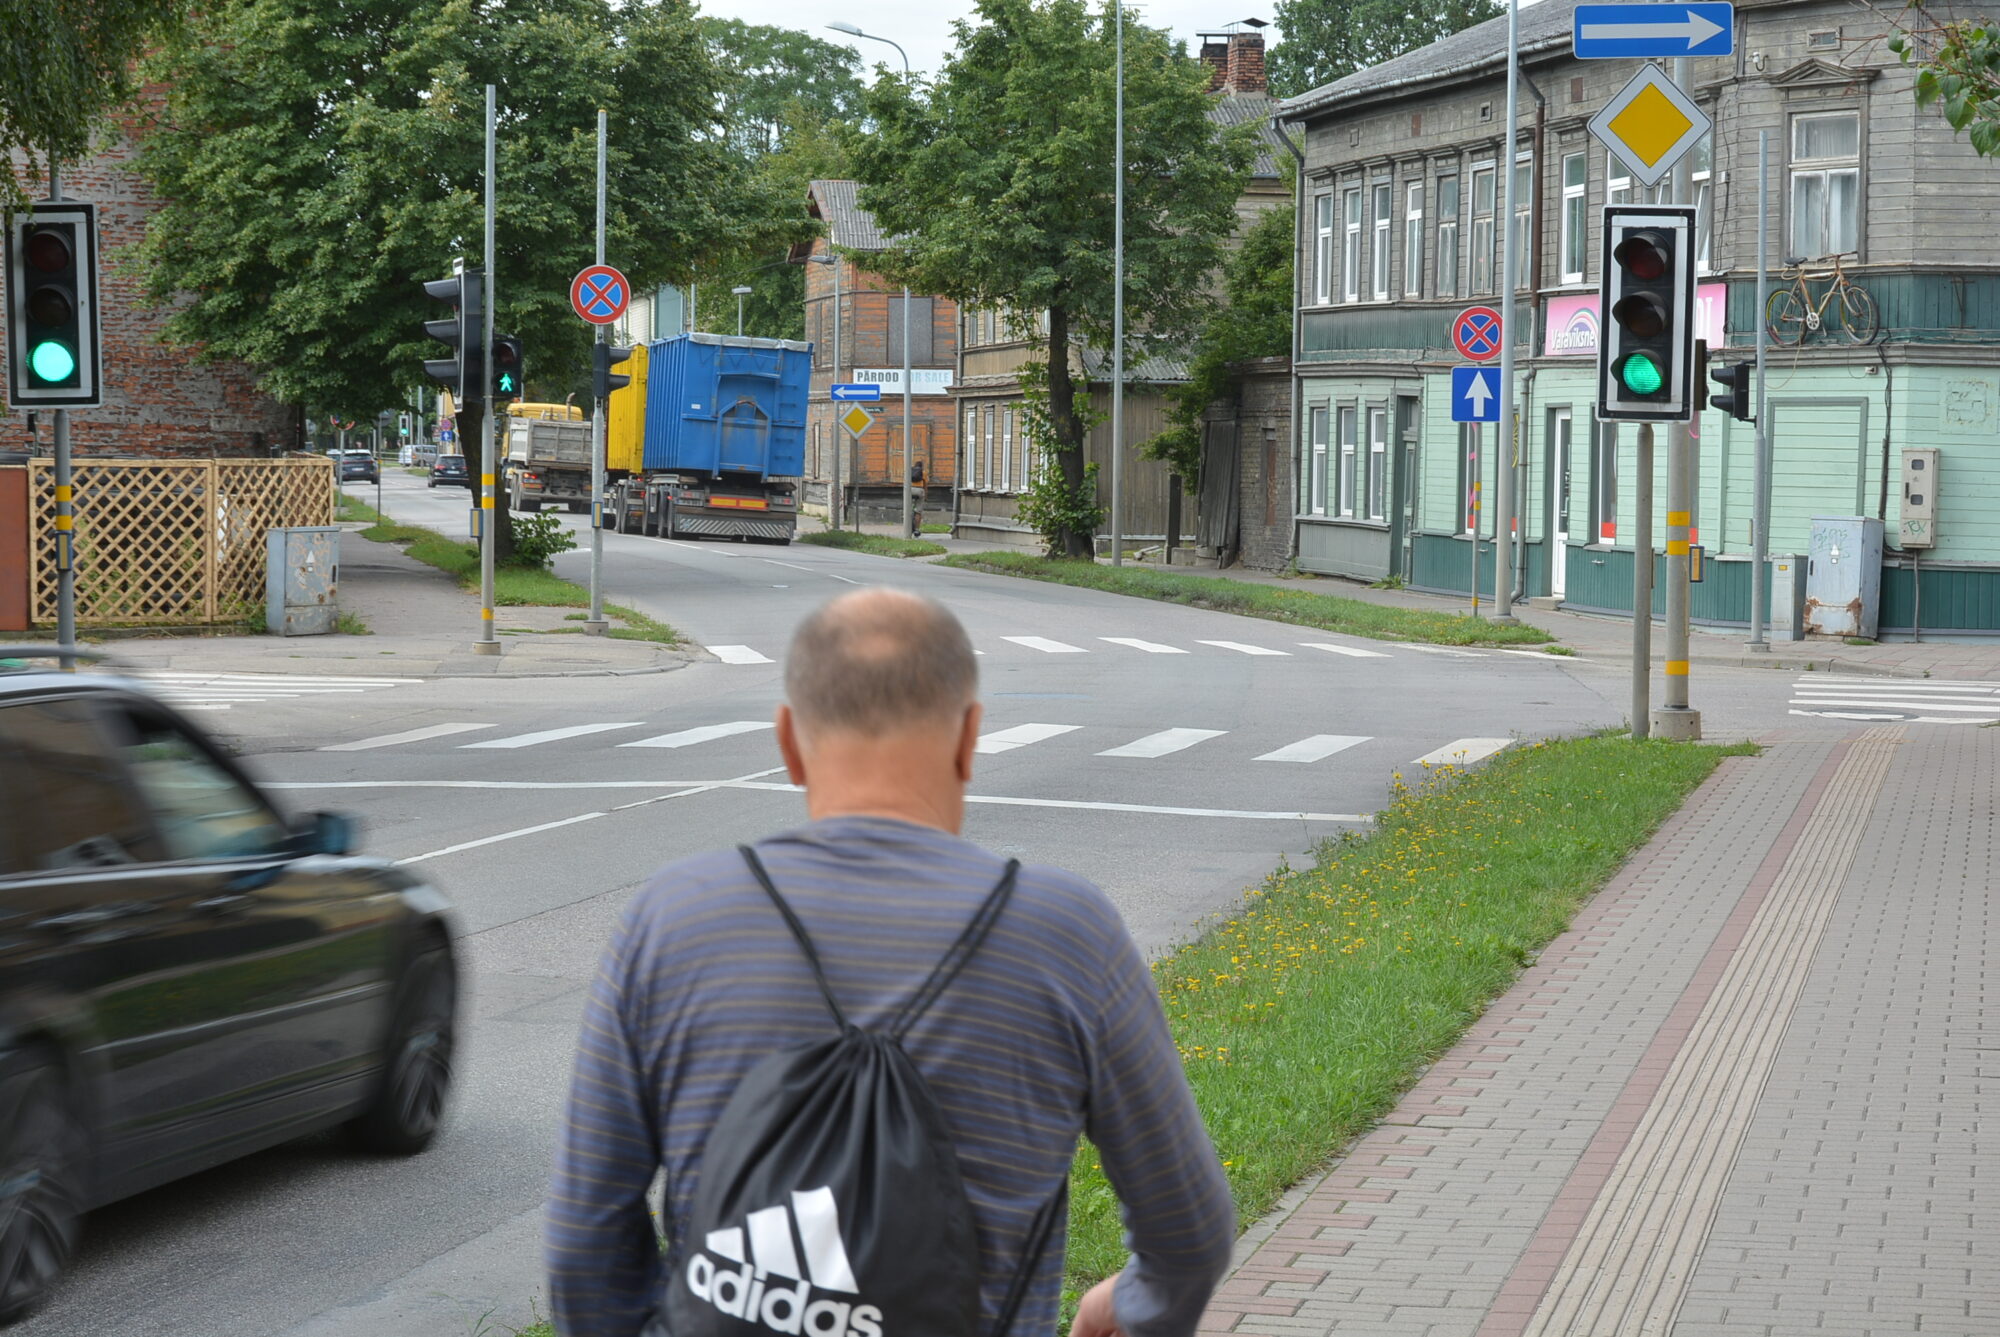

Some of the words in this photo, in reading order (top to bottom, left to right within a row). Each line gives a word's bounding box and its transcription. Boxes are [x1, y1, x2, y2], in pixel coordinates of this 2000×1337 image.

[1551, 327, 1595, 349] Varaviksne
[857, 370, 899, 383] PĀRDOD
[925, 372, 950, 383] SALE
[687, 1252, 883, 1337] adidas
